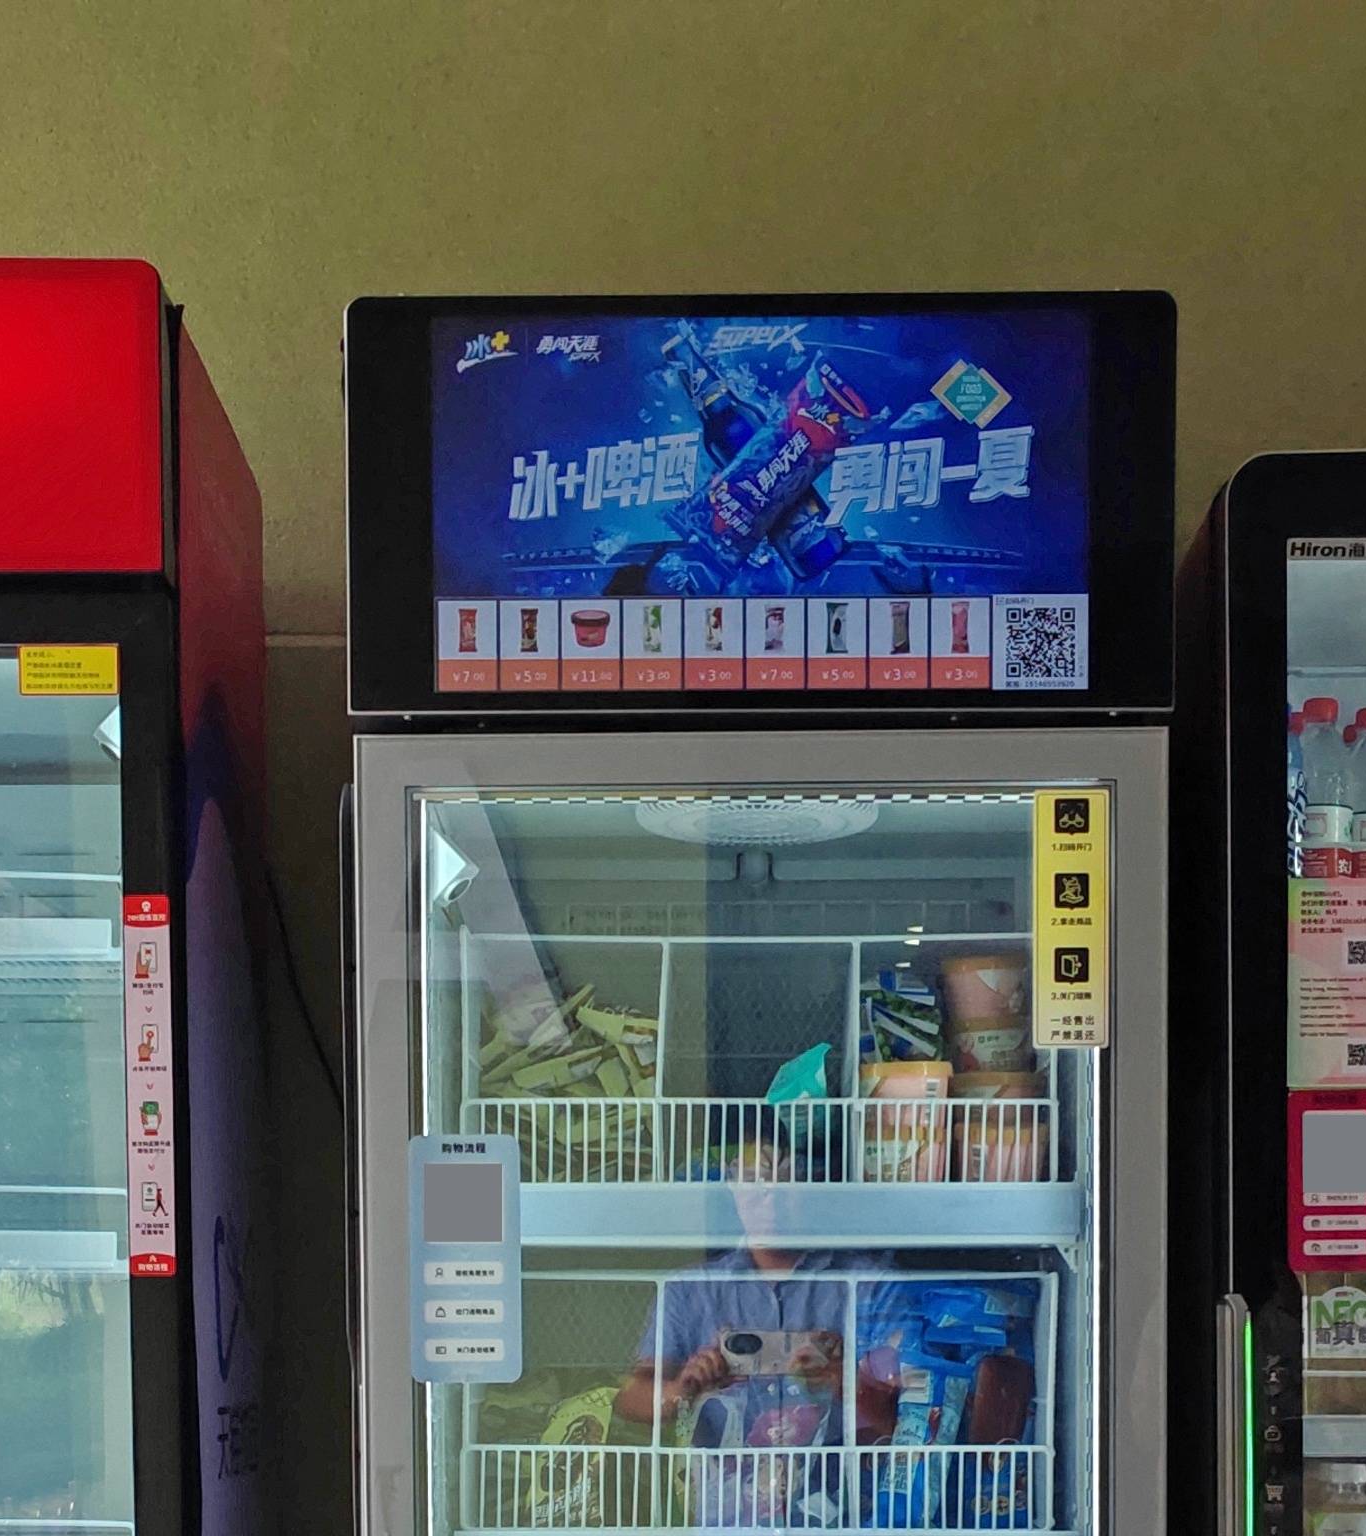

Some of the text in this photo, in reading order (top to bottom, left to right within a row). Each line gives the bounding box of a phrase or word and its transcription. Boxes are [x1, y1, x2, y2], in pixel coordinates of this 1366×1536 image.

[536, 335, 600, 355] 勇闯天涯
[509, 431, 701, 521] 冰+啤酒
[823, 425, 1036, 527] 勇闯一夏
[1290, 542, 1346, 558] Hiron
[1051, 1015, 1095, 1026] 一经售出
[442, 1142, 486, 1154] 购物流程
